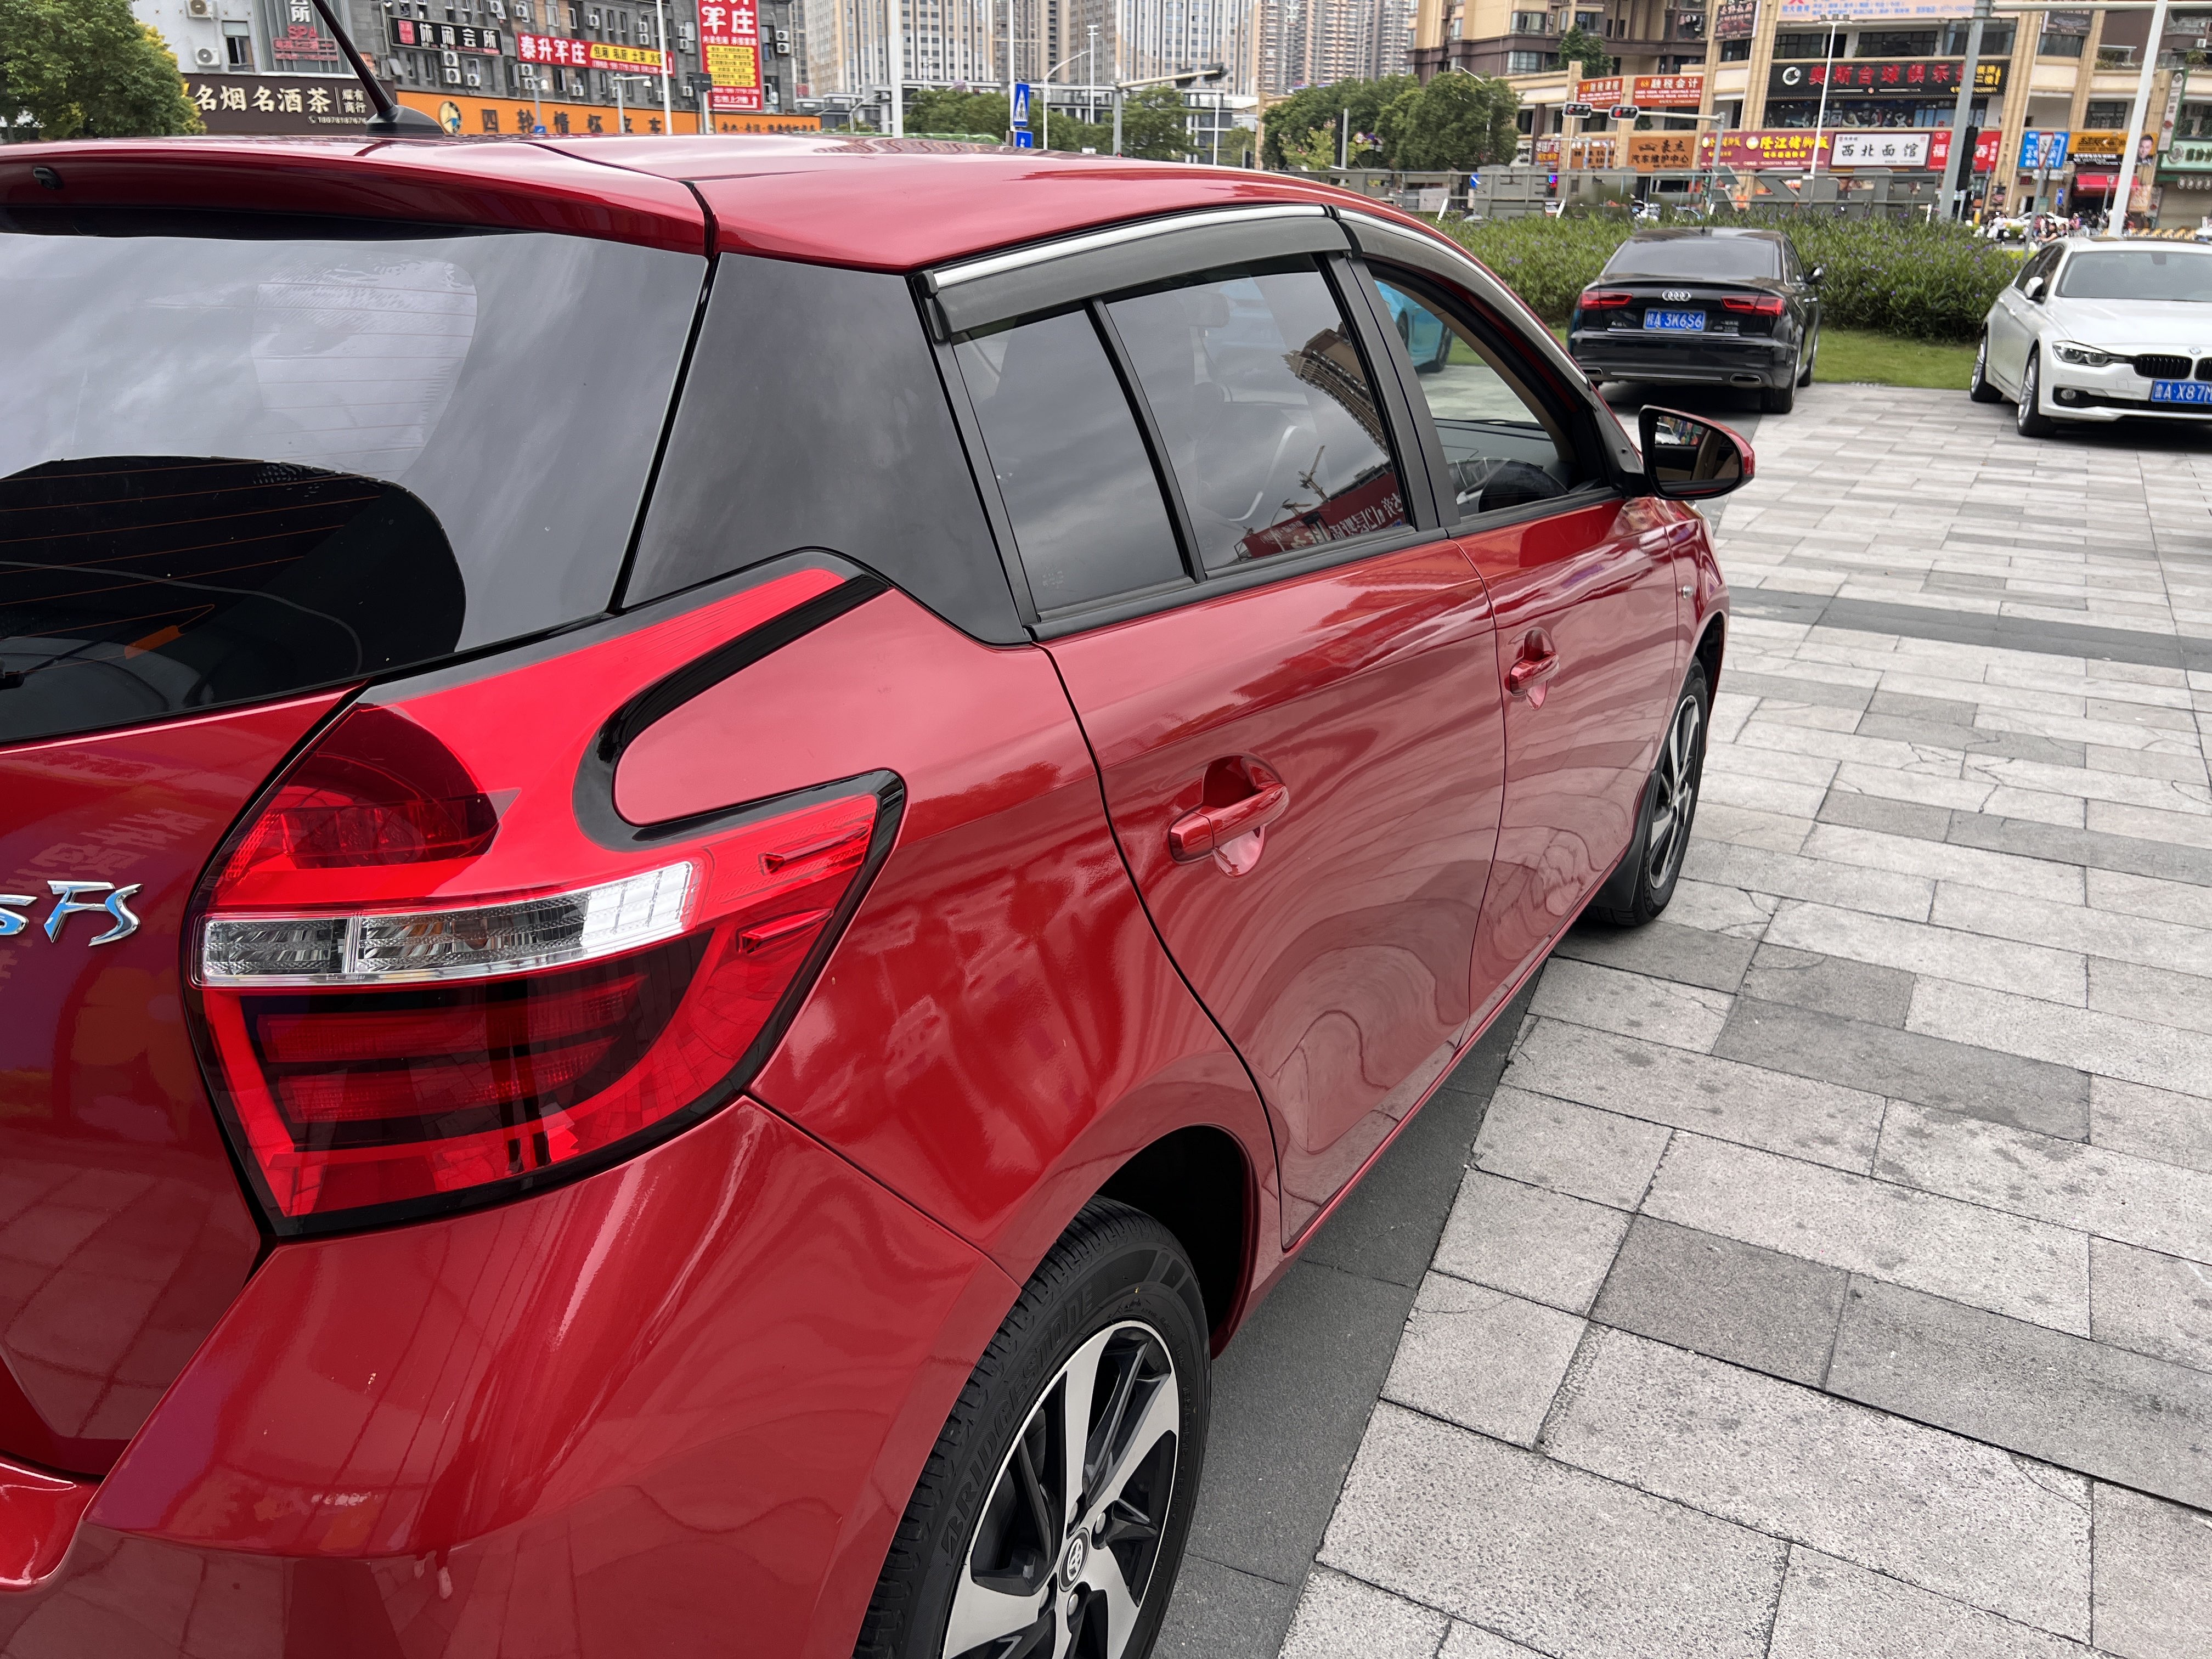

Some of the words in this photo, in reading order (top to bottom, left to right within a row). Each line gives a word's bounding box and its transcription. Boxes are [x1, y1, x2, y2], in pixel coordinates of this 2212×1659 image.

[288, 26, 318, 40] SPA
[195, 83, 332, 114] 名烟名酒茶
[1841, 143, 1918, 157] 西北面馆
[44, 880, 144, 947] FS
[941, 1290, 1094, 1559] BRIDGESTONE
